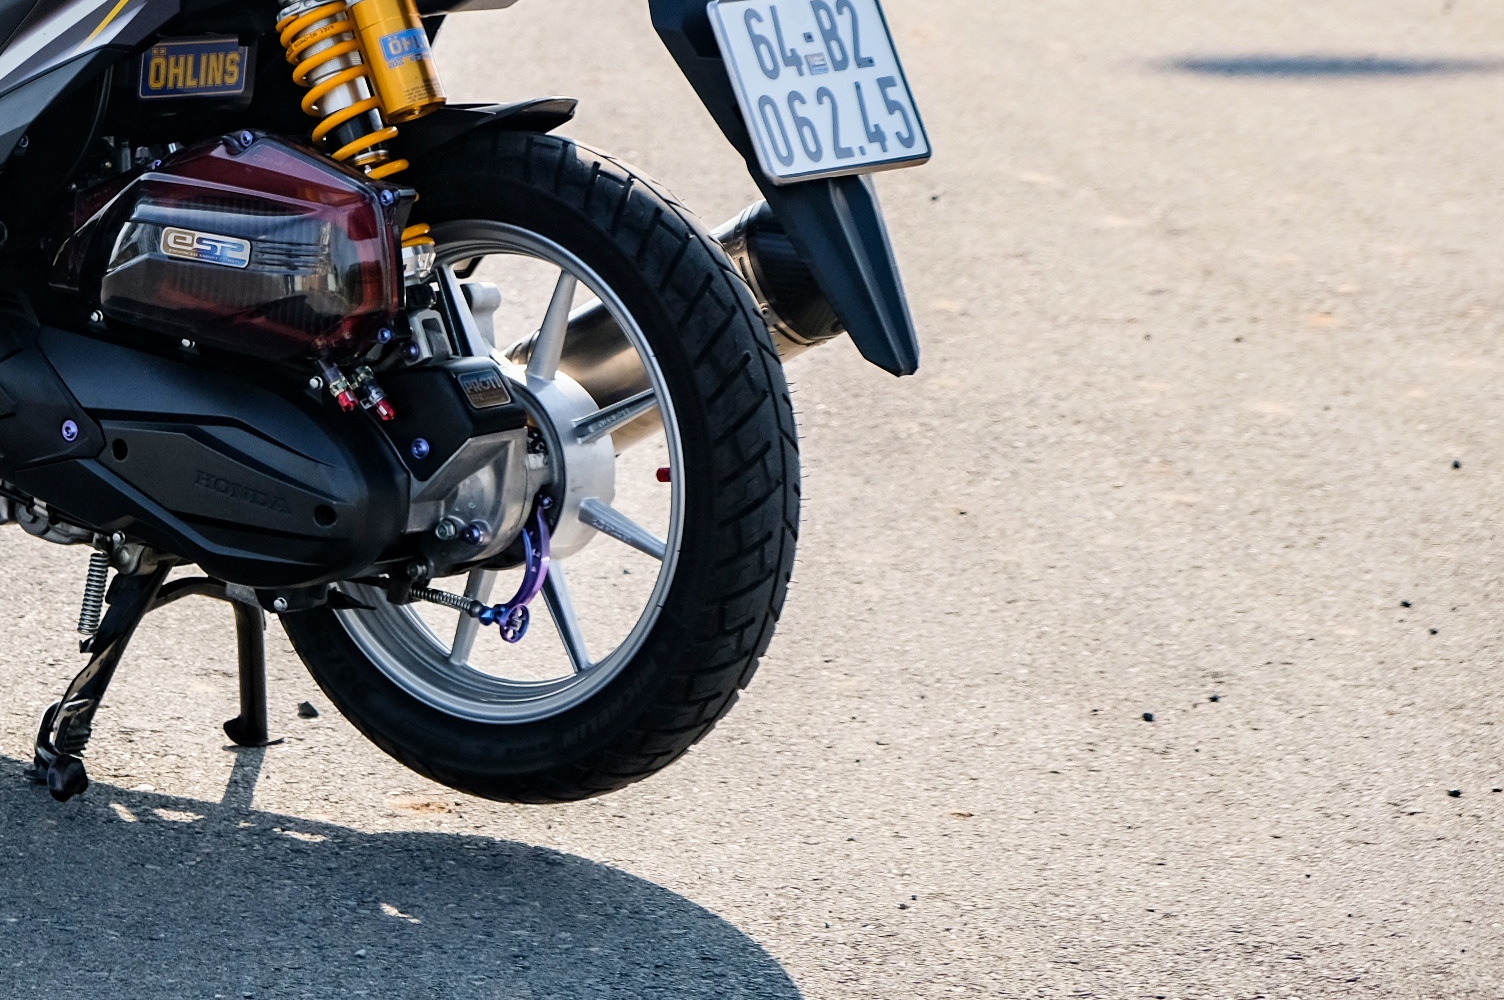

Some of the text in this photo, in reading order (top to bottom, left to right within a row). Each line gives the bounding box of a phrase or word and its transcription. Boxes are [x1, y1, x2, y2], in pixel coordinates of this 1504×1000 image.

[149, 47, 241, 90] ÖHLINS
[758, 75, 916, 167] 062.45
[463, 376, 502, 393] PROTI
[194, 468, 293, 515] HONDA
